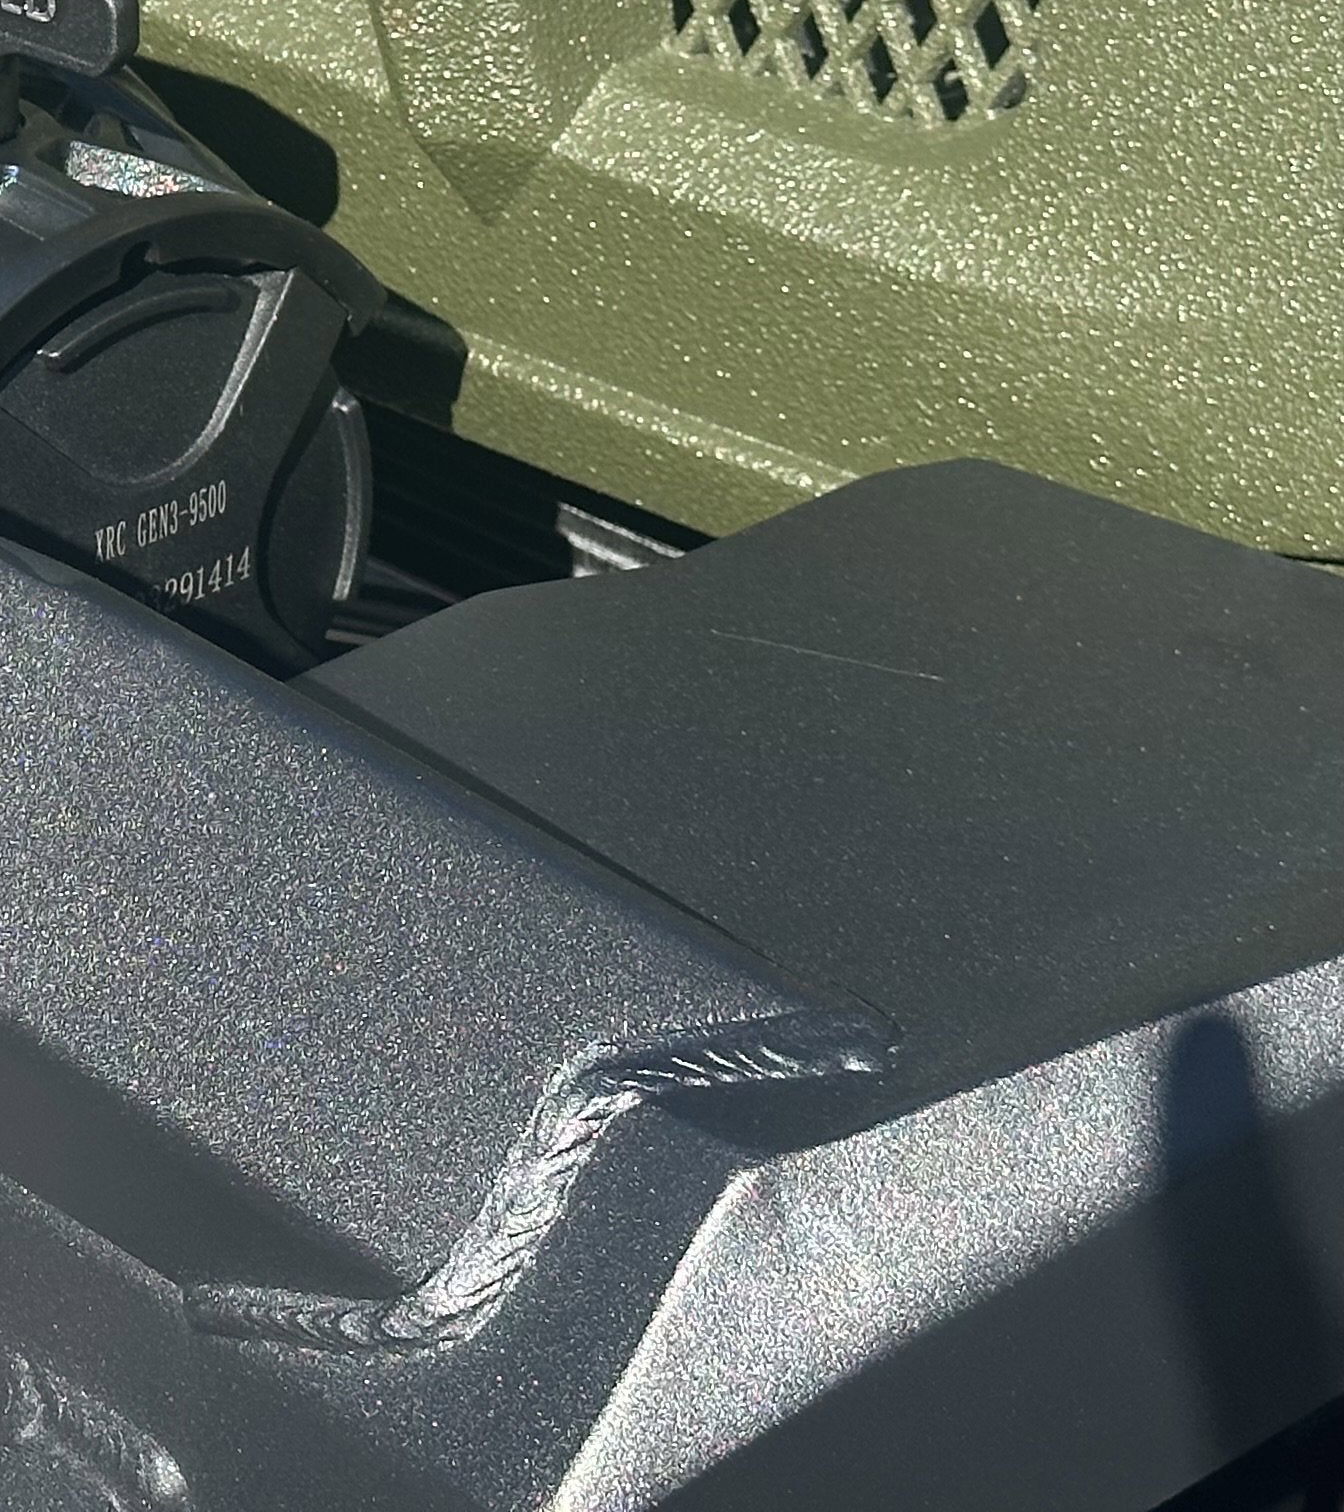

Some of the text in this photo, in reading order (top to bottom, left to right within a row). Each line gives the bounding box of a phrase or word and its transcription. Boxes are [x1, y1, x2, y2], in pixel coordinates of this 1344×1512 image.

[94, 479, 227, 563] XRC GEN3-9500
[153, 545, 251, 611] 291414
